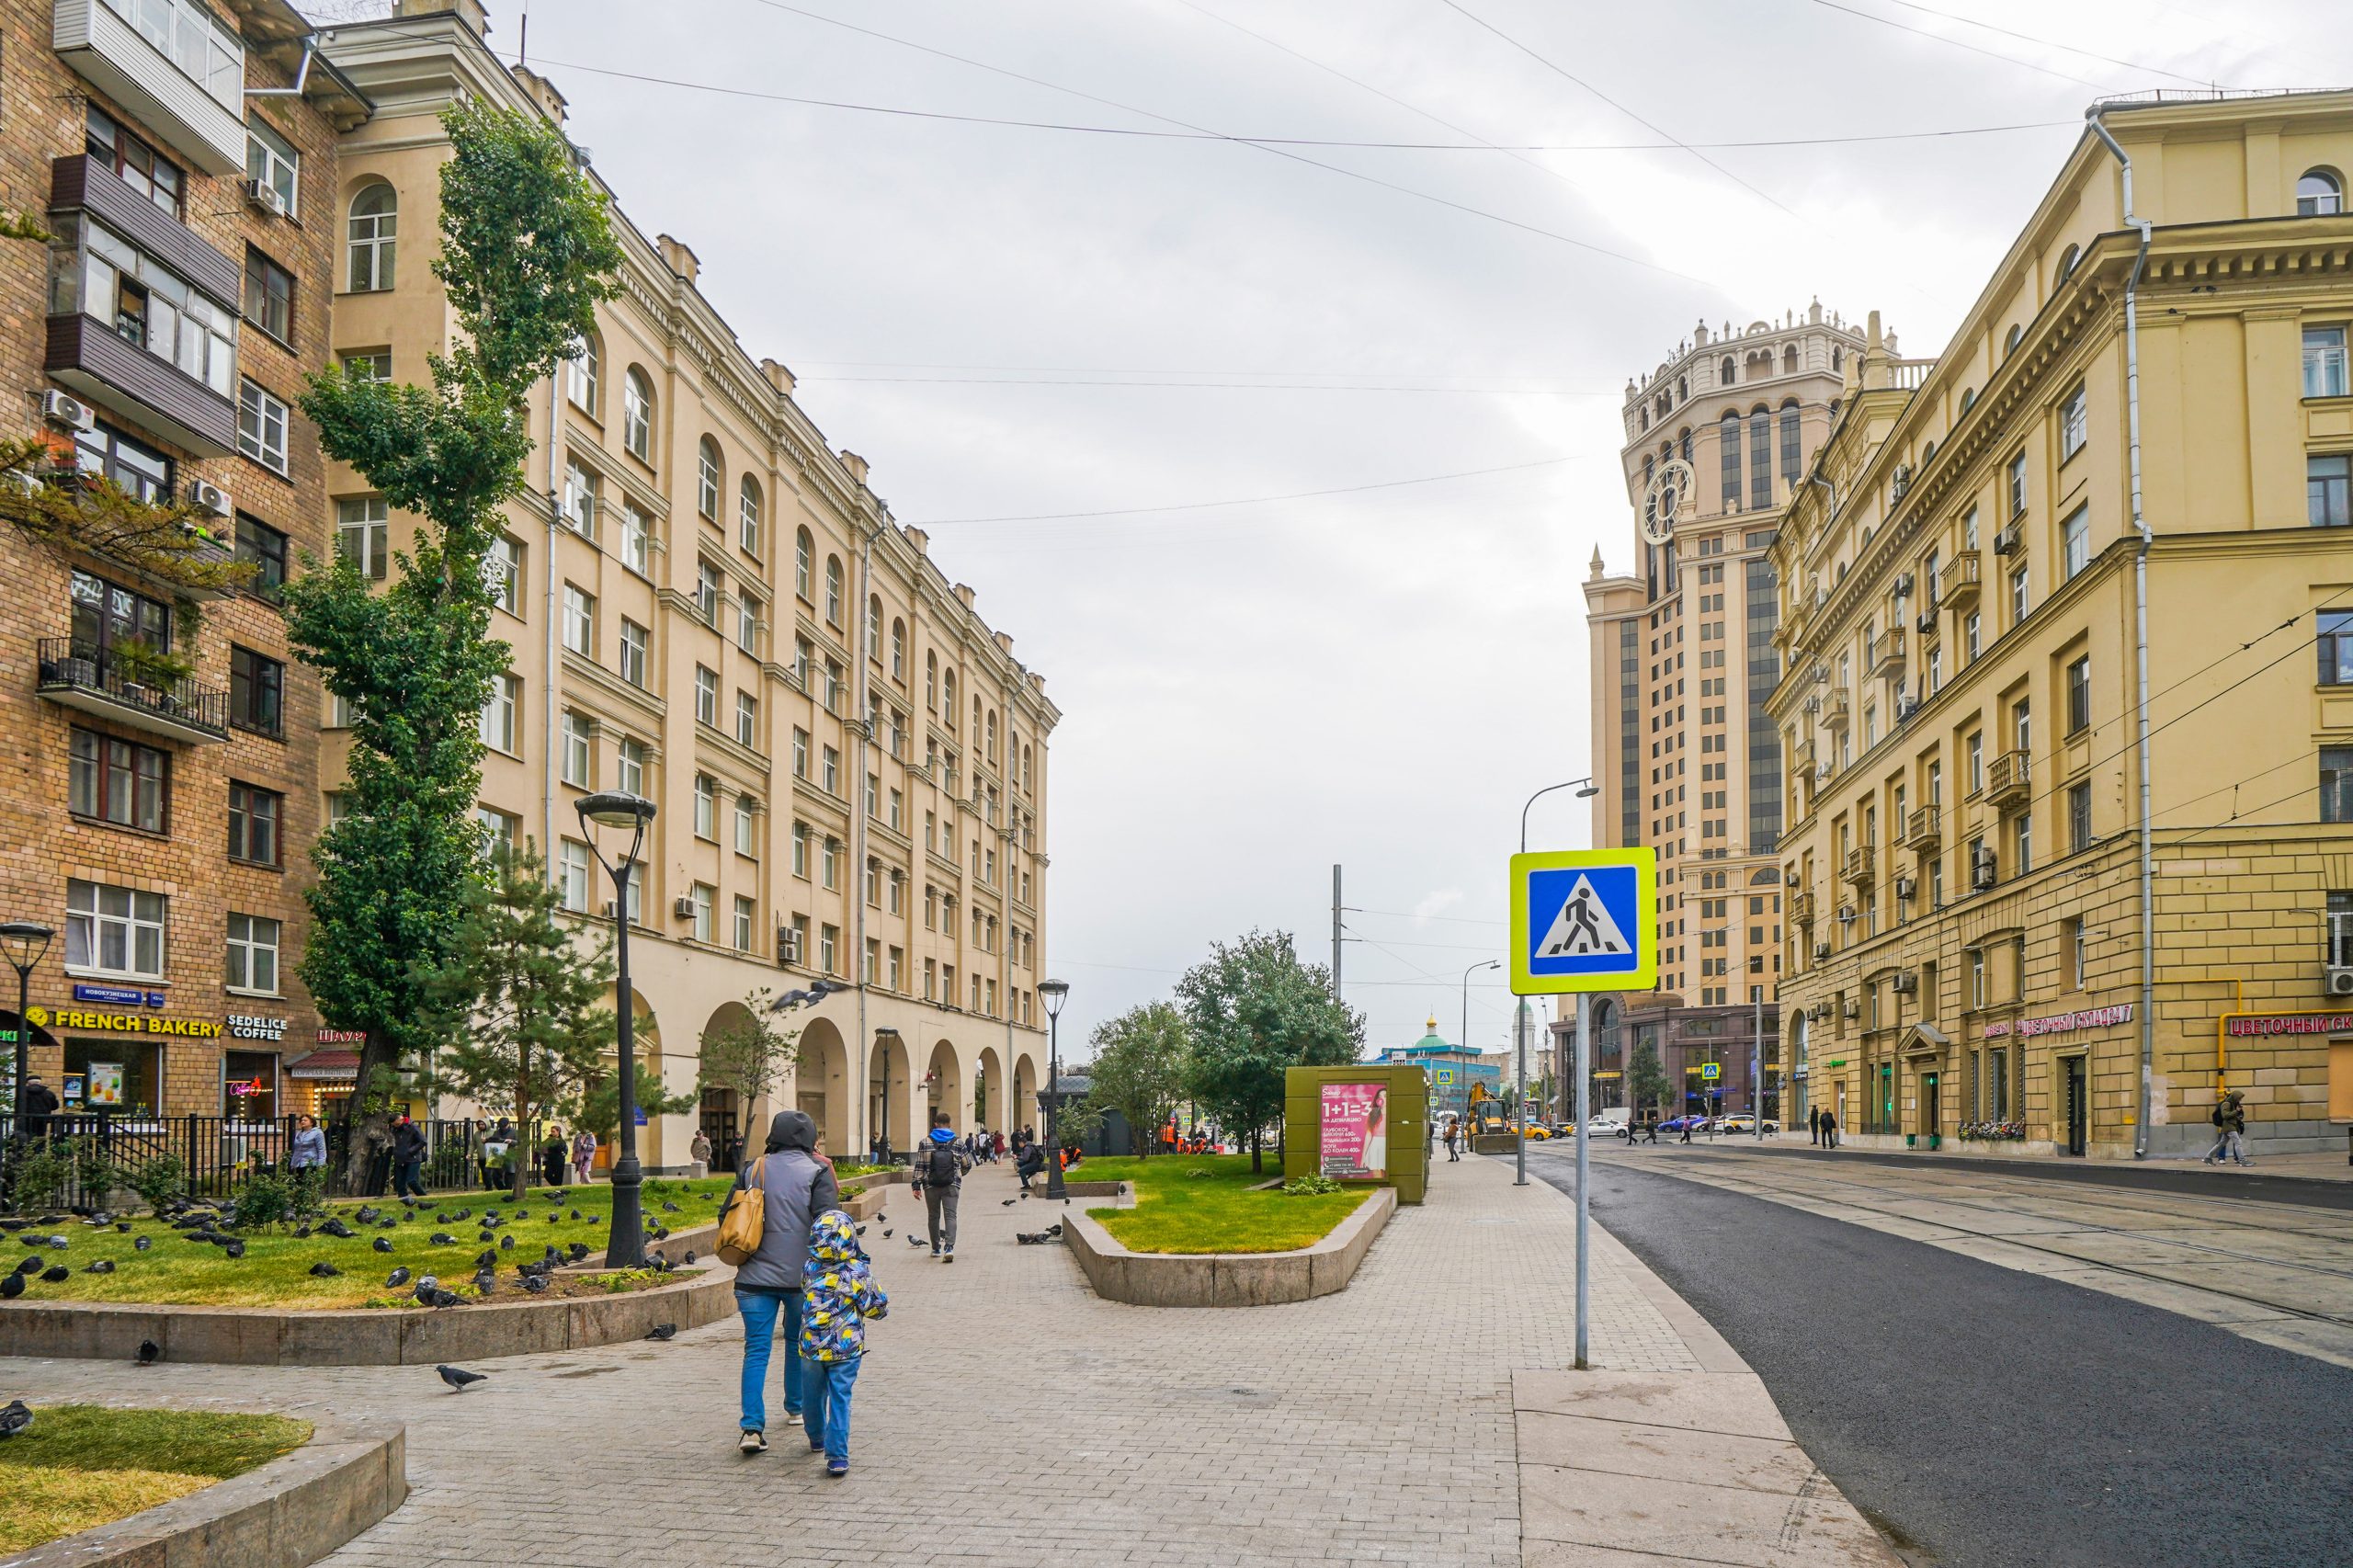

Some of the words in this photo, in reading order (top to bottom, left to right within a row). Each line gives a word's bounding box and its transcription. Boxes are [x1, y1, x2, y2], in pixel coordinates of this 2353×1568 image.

[85, 989, 137, 999] НОВОКУЗНЕЦКАЯ
[55, 1011, 141, 1031] FRENCH
[148, 1017, 223, 1037] BAKERY
[227, 1015, 288, 1030] SEDELICE
[2021, 1013, 2074, 1037] ЦВЕТОЧНЫЙ
[2075, 1009, 2109, 1029] СКЛАД
[2231, 1015, 2328, 1036] ЦВЕТОЧНЫЙ
[233, 1027, 282, 1040] COFFEE
[318, 1028, 367, 1042] ШАУР
[1323, 1101, 1372, 1117] 1+1=3
